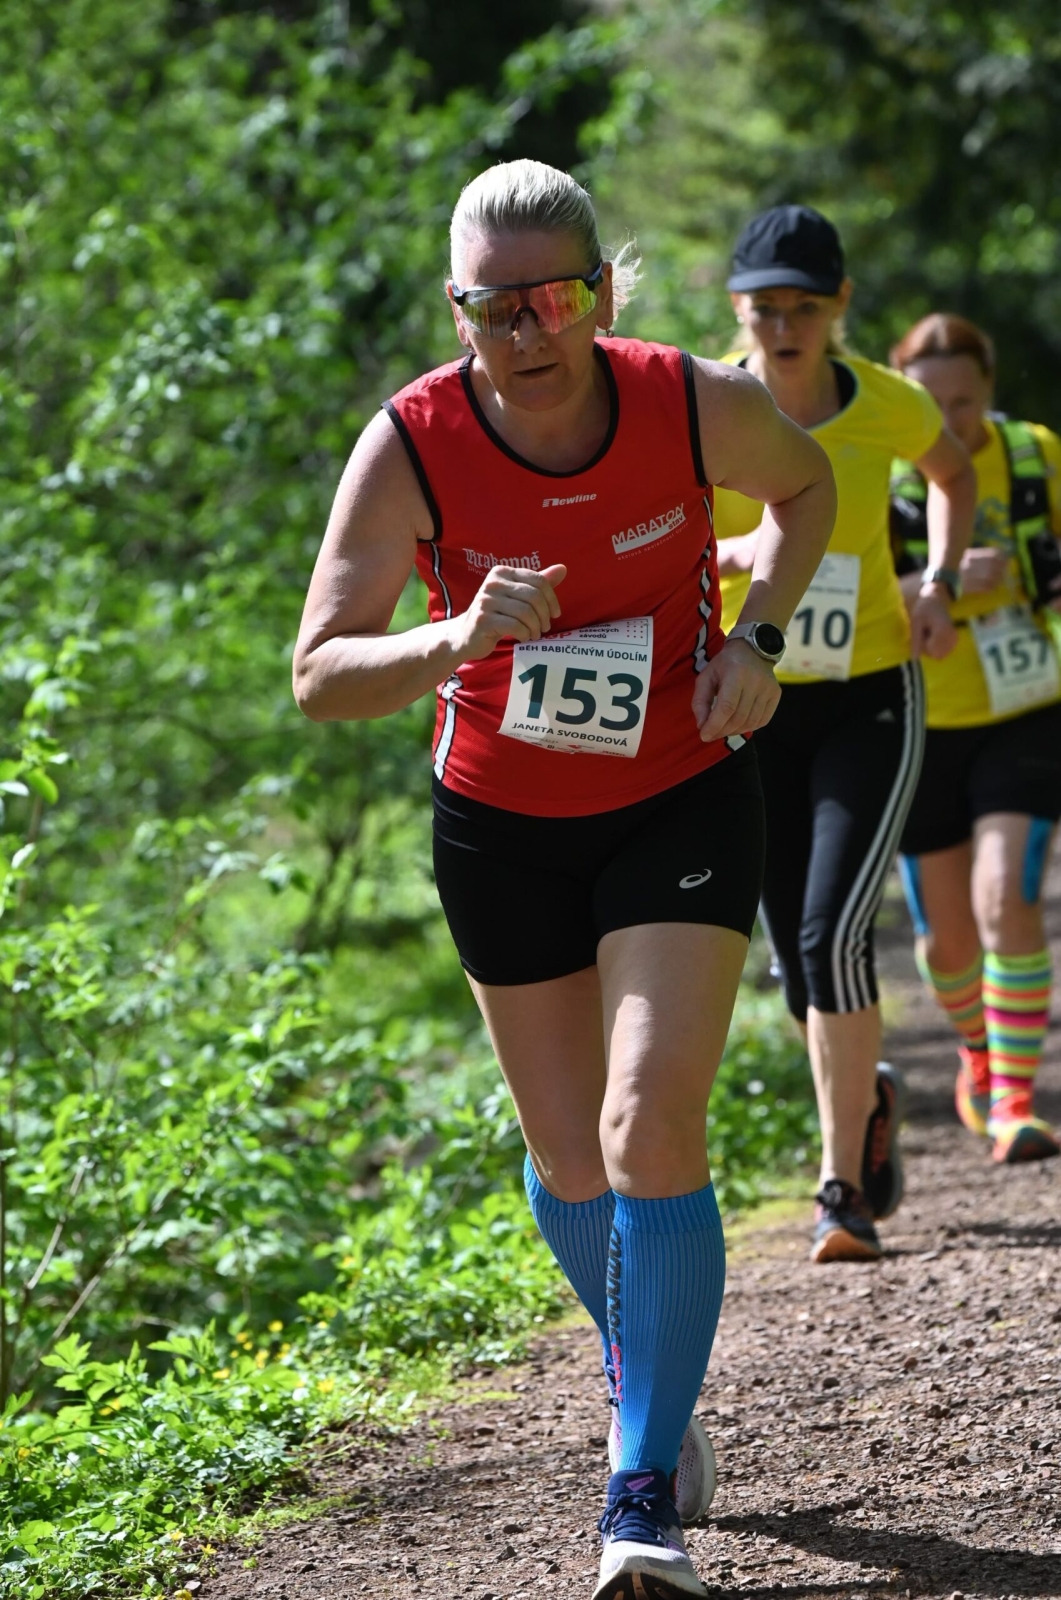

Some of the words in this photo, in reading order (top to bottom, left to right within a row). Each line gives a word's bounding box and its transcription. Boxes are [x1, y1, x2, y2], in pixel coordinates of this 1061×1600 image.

[611, 502, 684, 545] MARATON
[668, 516, 683, 530] stav
[541, 644, 604, 658] BABIČČINÝM
[607, 649, 648, 662] ÚDOLÍM
[985, 632, 1049, 675] 157
[517, 663, 644, 732] 153
[512, 723, 554, 734] JANETA
[557, 729, 628, 747] SVOBODOVÁ
